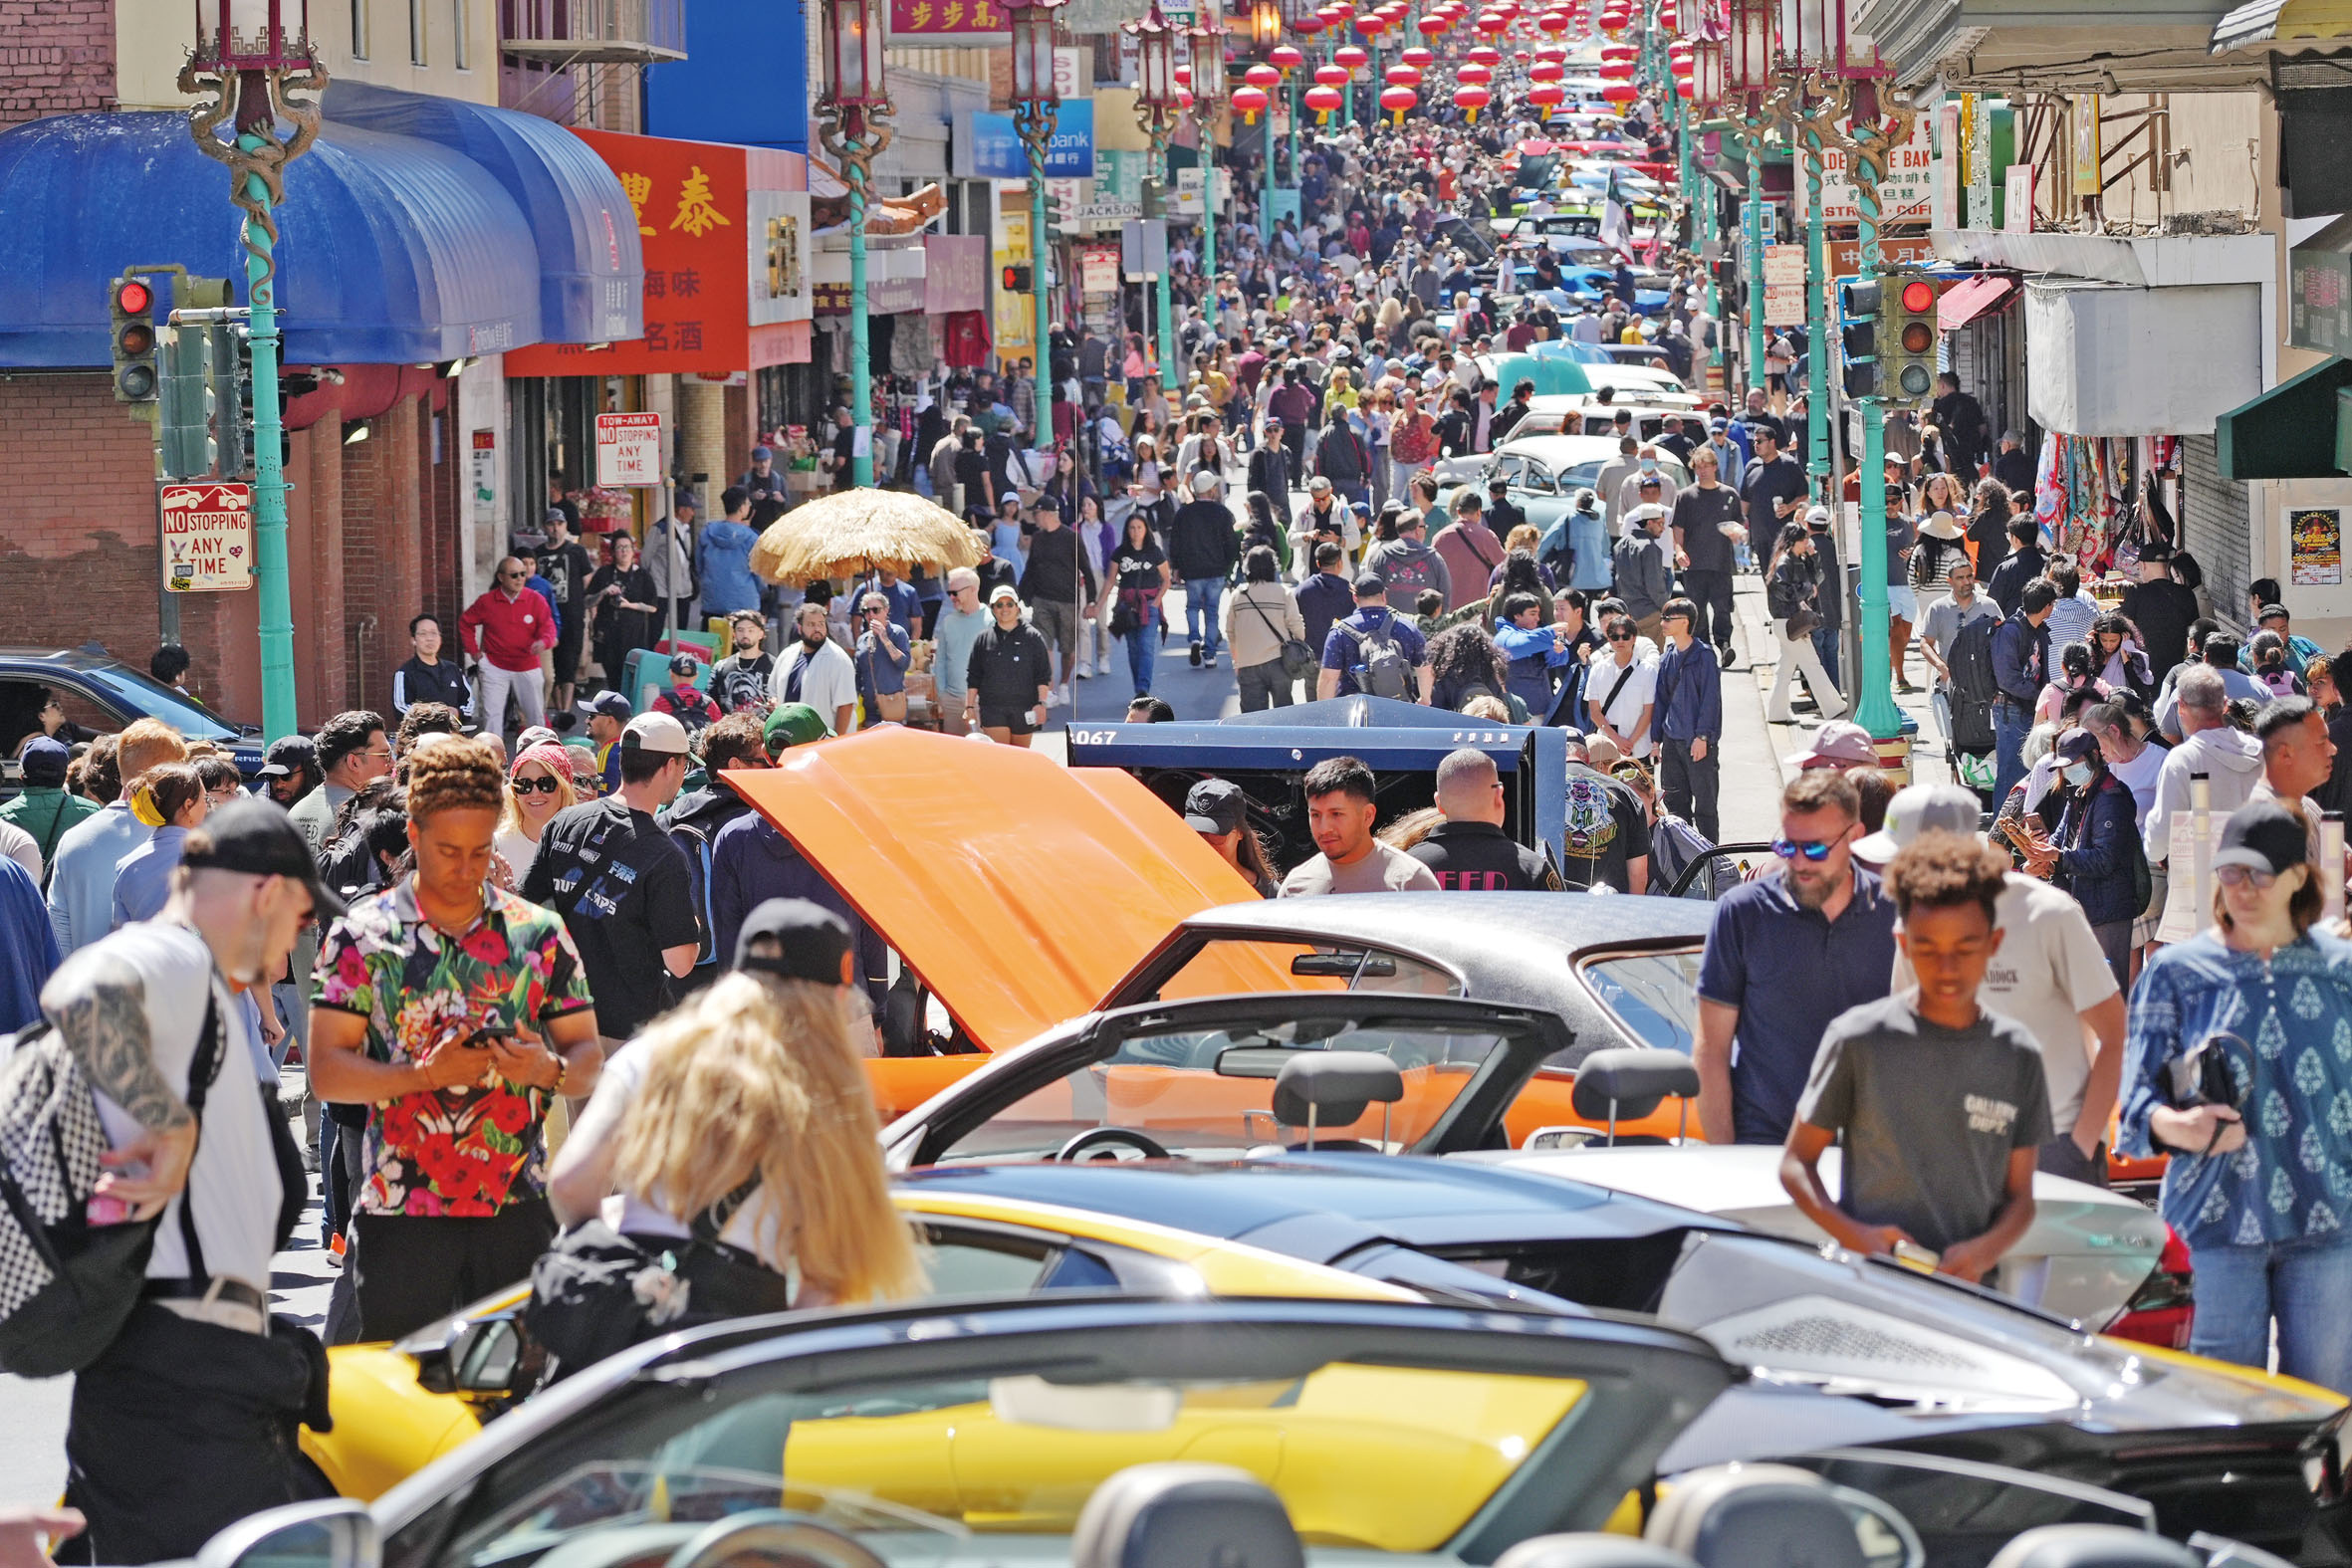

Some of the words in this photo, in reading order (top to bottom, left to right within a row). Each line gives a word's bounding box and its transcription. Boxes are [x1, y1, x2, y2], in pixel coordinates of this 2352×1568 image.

[909, 0, 998, 30] 步步高
[1078, 205, 1141, 217] JACKSON
[643, 267, 701, 298] 海味
[643, 321, 703, 350] 名酒
[602, 415, 654, 426] TOW-AWAY
[599, 427, 615, 443] NO
[617, 429, 657, 442] STOPPING
[617, 446, 640, 457] ANY
[616, 459, 643, 472] TIME
[165, 511, 186, 532] NO
[189, 513, 247, 532] STOPPING
[191, 538, 223, 555] ANY
[188, 558, 227, 574] TIME
[1069, 731, 1117, 746] 067
[1453, 732, 1510, 744] FORD
[1964, 1093, 2019, 1122] GALLERY
